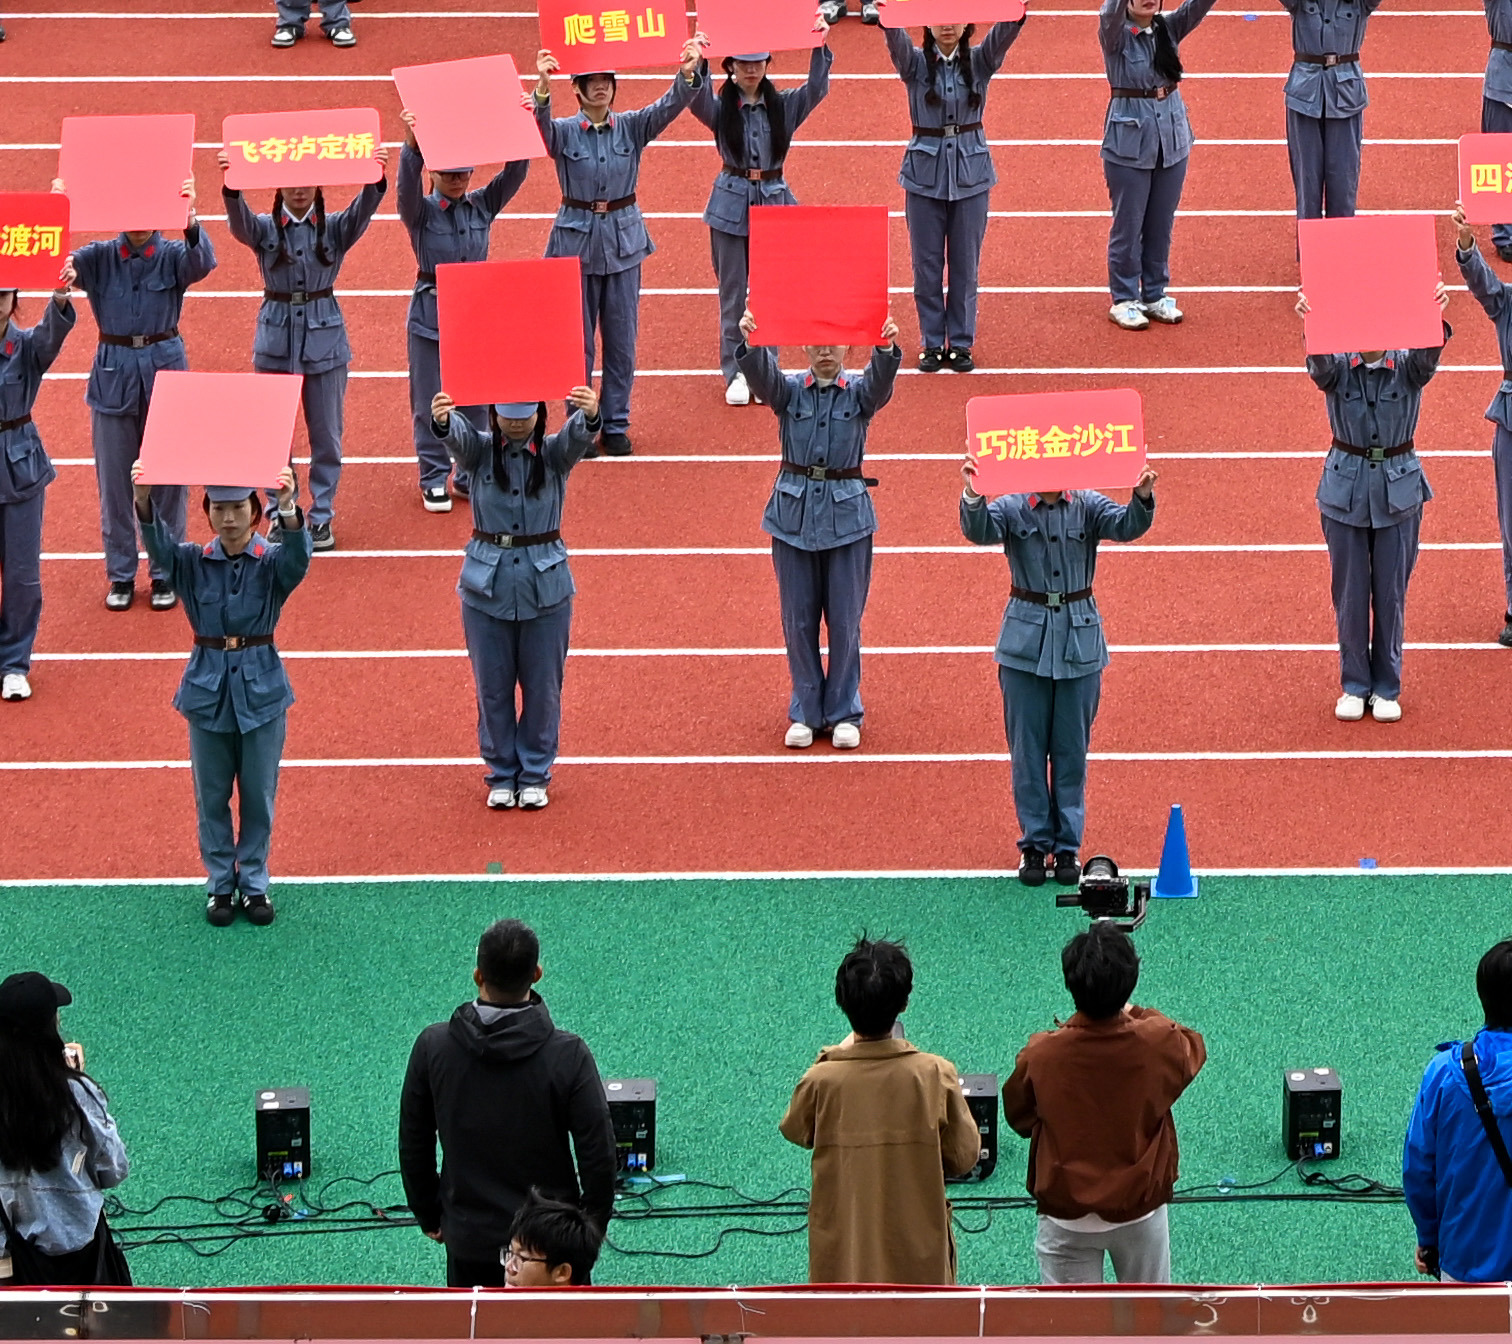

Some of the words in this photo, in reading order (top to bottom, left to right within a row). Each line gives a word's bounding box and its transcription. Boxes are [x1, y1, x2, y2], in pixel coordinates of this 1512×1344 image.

[563, 7, 666, 45] 爬雪山
[230, 132, 375, 165] 飞夺泸定桥
[977, 422, 1137, 461] 巧渡金沙江
